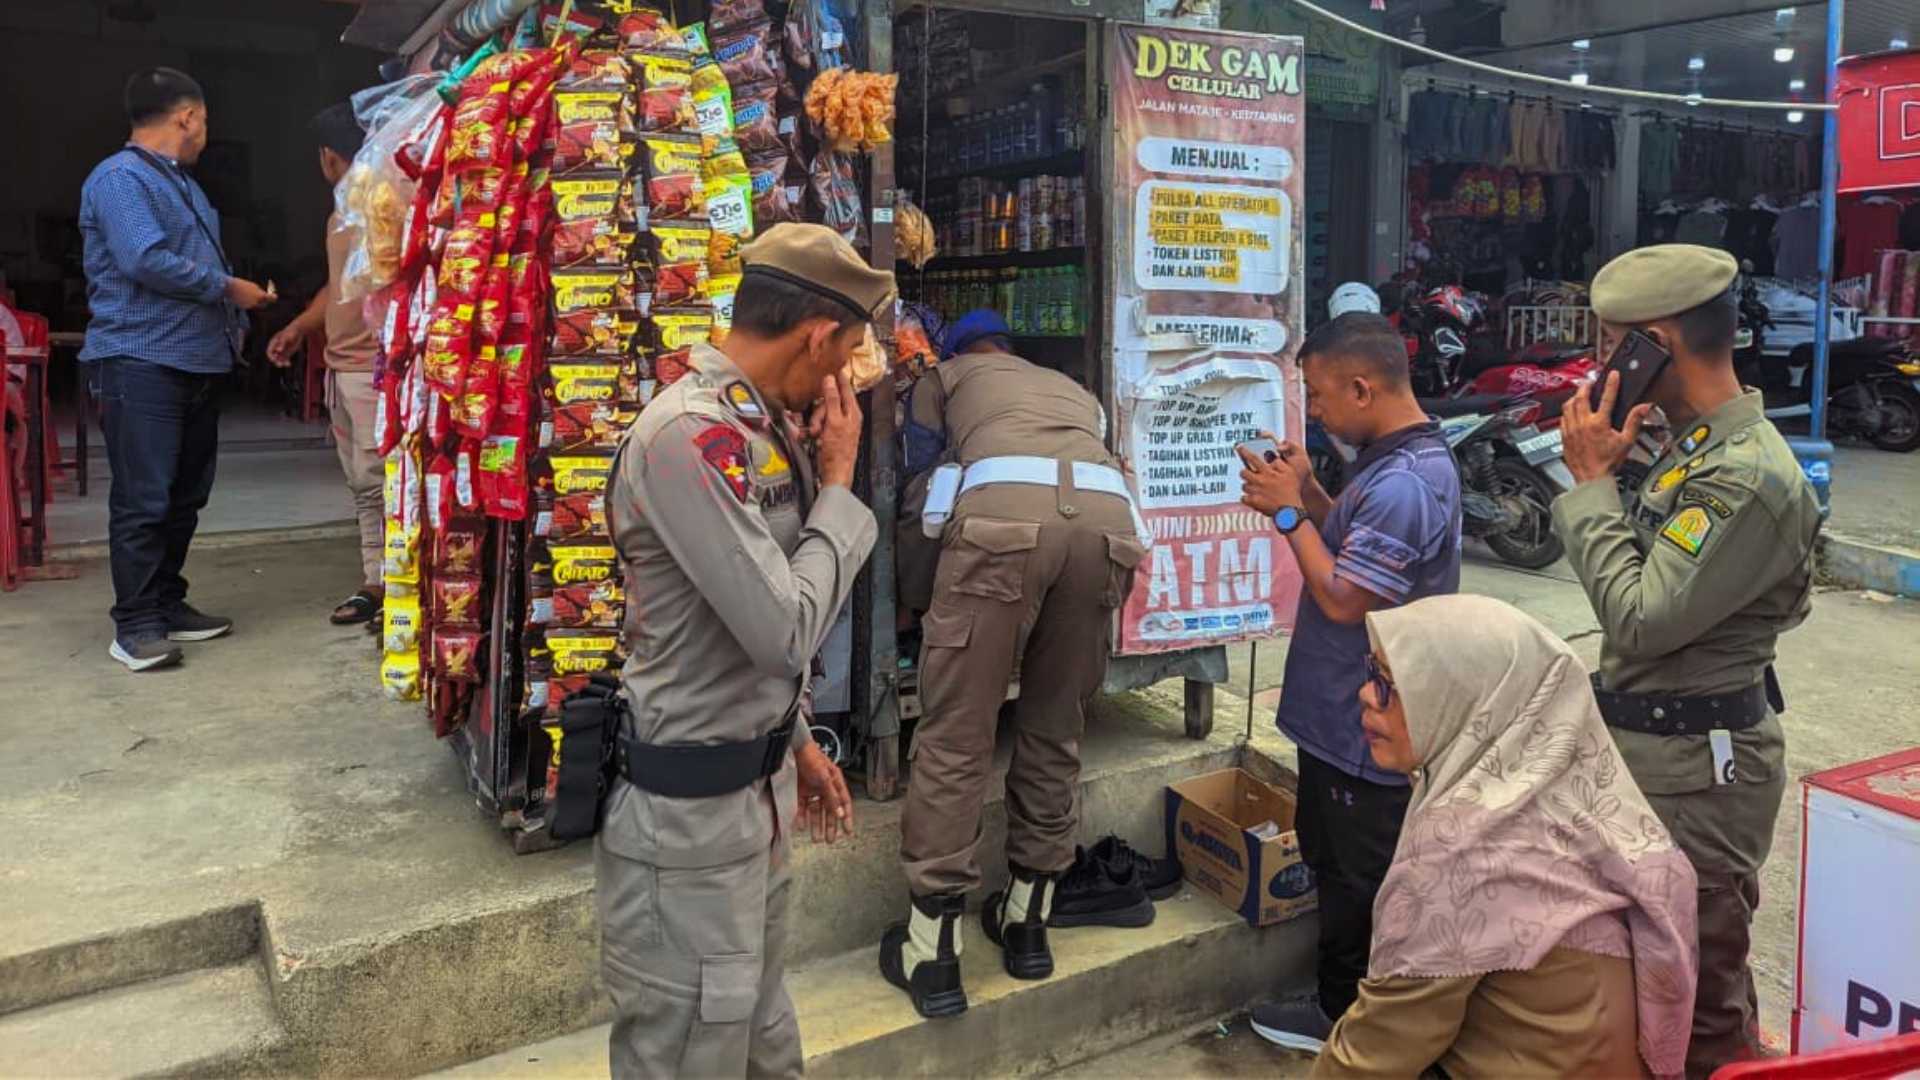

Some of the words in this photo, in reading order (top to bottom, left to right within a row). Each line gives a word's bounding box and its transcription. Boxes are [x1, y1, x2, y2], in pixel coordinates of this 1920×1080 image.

[1134, 35, 1213, 79] DEK
[1221, 47, 1300, 95] GAM
[1167, 75, 1262, 100] CELLULAR
[1139, 99, 1175, 112] JALAN
[1171, 146, 1250, 171] MENJUAL
[1156, 191, 1191, 207] PULSA
[1195, 194, 1216, 209] ALL
[1218, 195, 1271, 213] OPERATOR
[1155, 210, 1189, 225] PAKET
[1193, 212, 1222, 226] DATA
[1155, 229, 1188, 243] PAKET
[1193, 230, 1237, 244] TELPON
[1247, 233, 1269, 247] SMS
[1153, 246, 1190, 261] TOKEN
[1194, 248, 1237, 262] LISTRIK
[1152, 263, 1175, 278] DAN
[1178, 264, 1237, 279] LAIN-LAIN
[1152, 415, 1171, 428] TOP
[1173, 416, 1188, 428] UP
[1231, 412, 1254, 425] PAY
[1149, 432, 1168, 445] TOP
[1171, 432, 1184, 444] UP
[1187, 430, 1215, 444] GRAB
[1148, 449, 1191, 462] TAGIHAN
[1194, 447, 1236, 461] LISTRIK
[1148, 467, 1192, 480] TAGIHAN
[1195, 464, 1229, 478] PDAM
[1149, 485, 1169, 498] DAN
[1172, 482, 1226, 497] LAIN-LAIN
[1146, 537, 1272, 609] ATM
